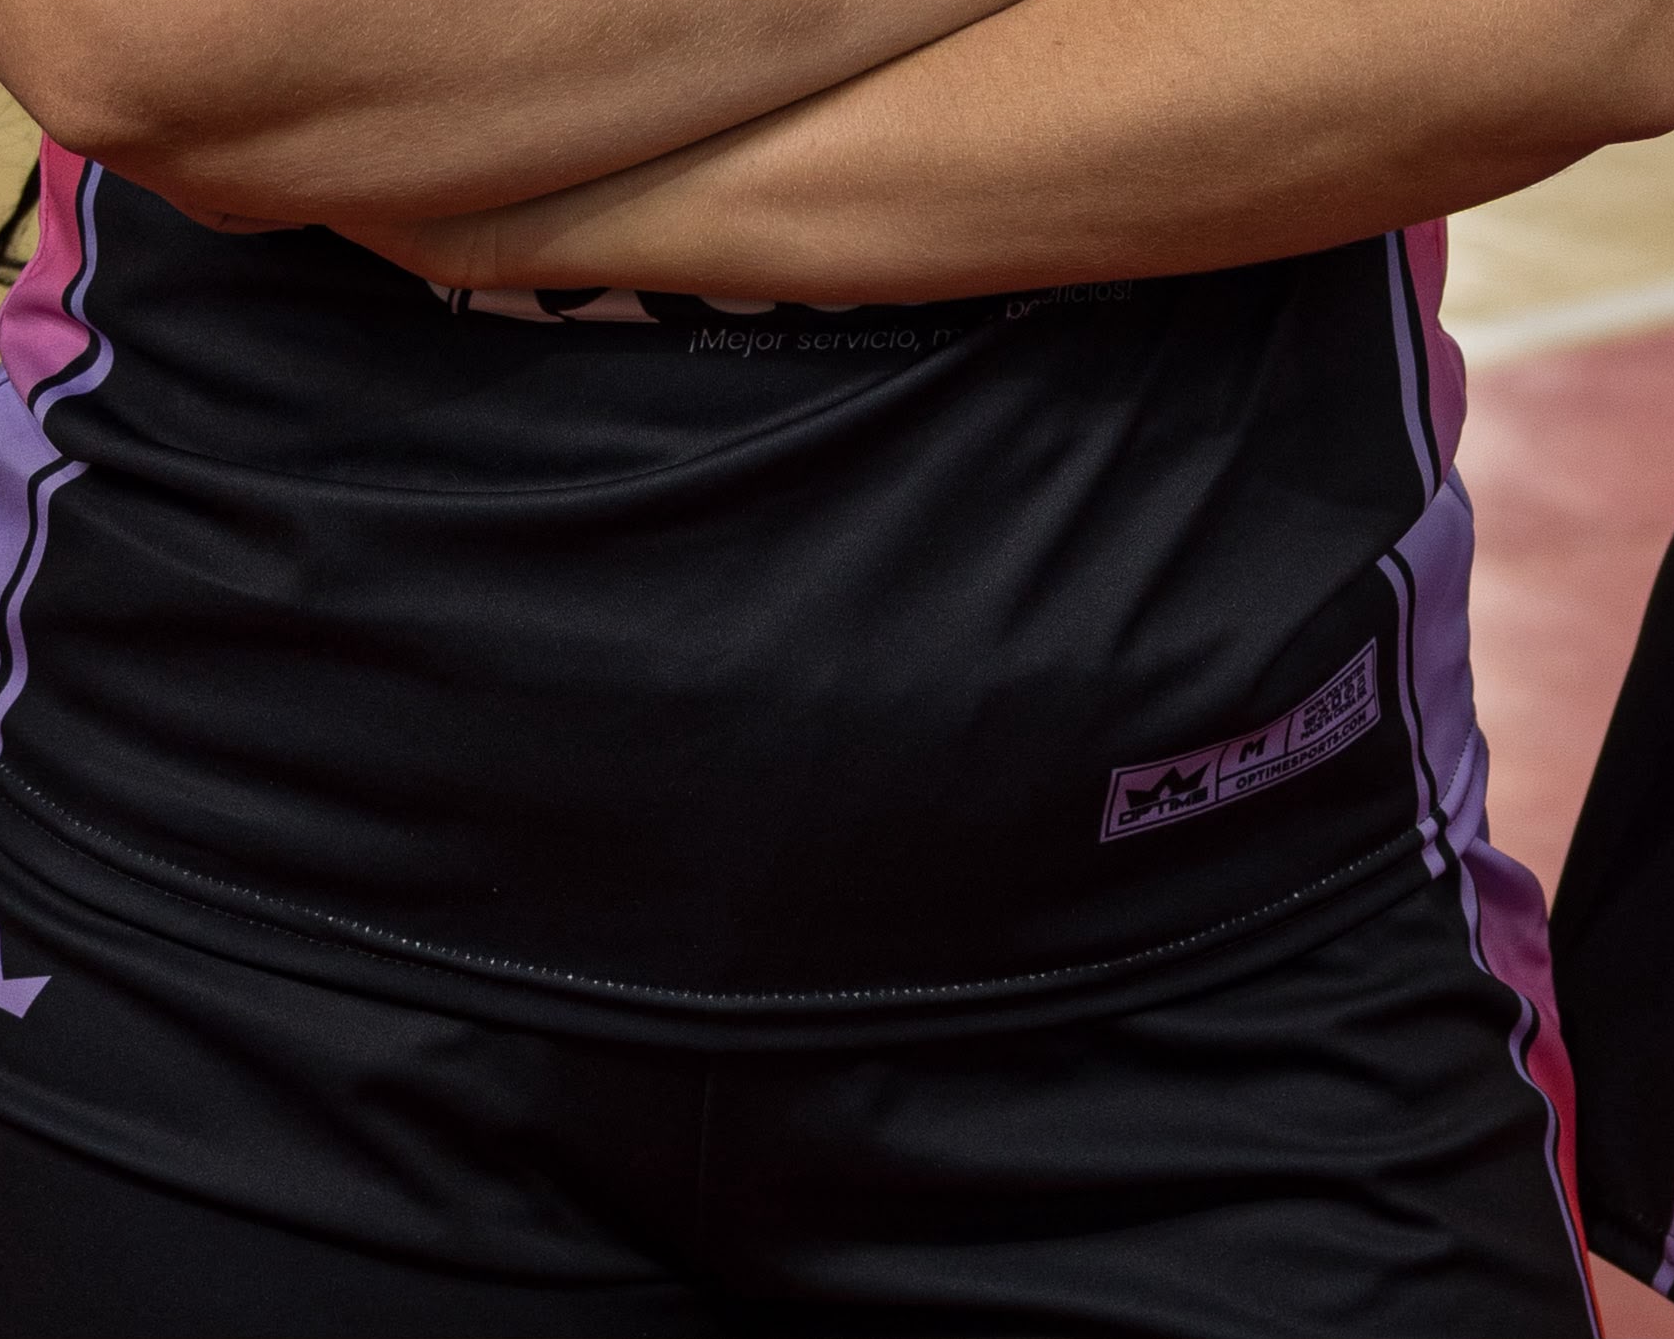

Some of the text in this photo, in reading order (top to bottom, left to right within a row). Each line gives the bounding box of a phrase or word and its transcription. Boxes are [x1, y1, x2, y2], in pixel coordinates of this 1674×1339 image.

[688, 326, 785, 358] ¡Mejor
[796, 324, 923, 352] servicio,
[1235, 709, 1368, 790] OPTIMESPORTS.COM
[1238, 734, 1267, 764] M
[1117, 786, 1209, 827] OPTIME
